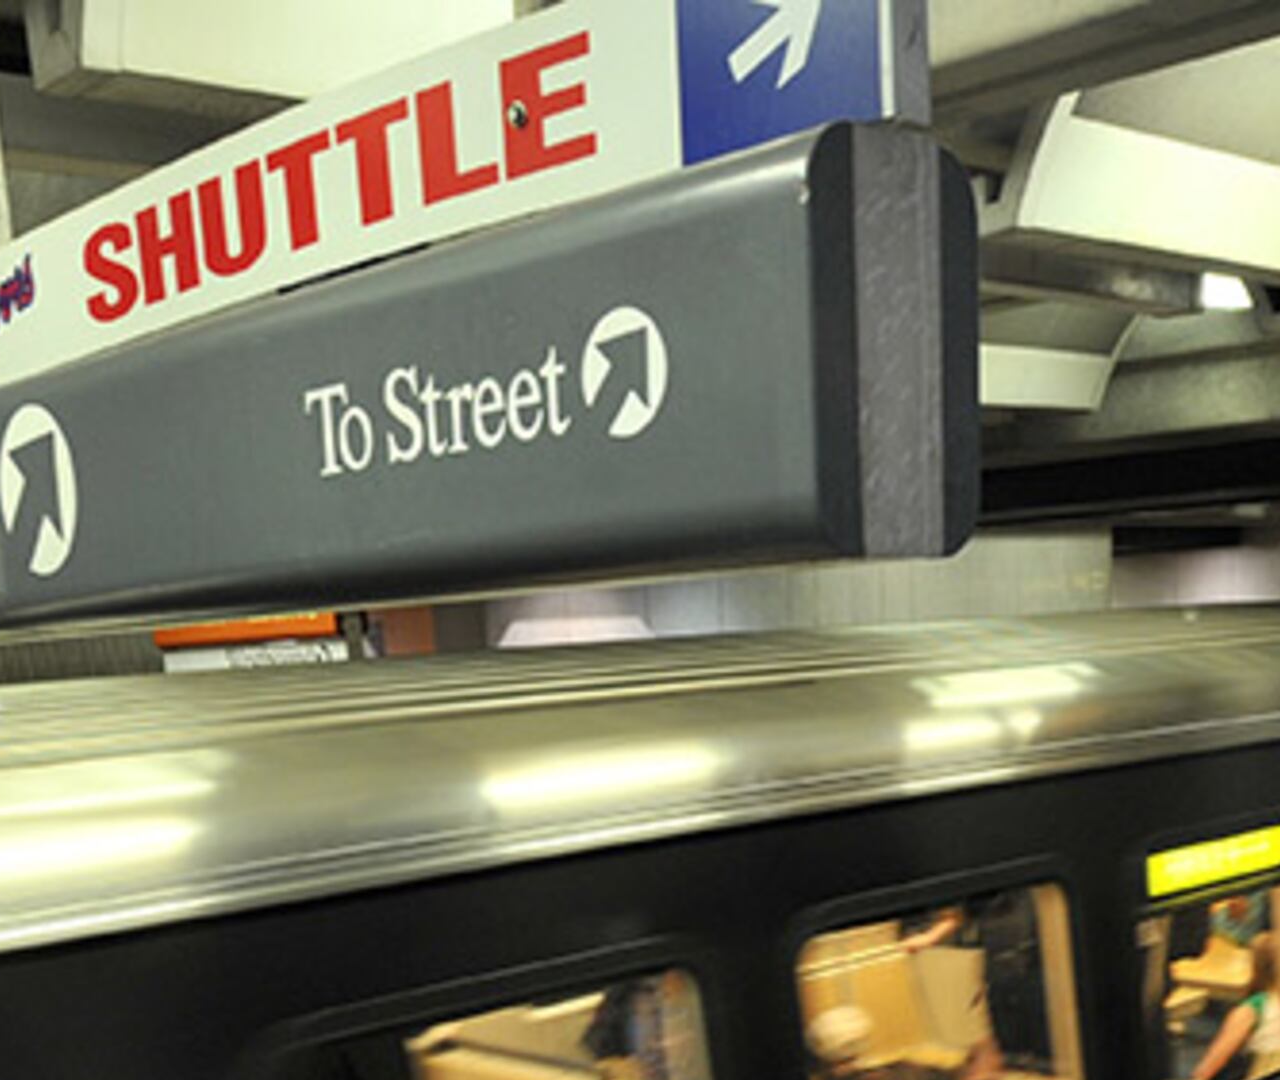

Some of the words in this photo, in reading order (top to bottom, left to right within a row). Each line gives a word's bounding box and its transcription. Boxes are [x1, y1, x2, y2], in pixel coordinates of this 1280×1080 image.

[83, 30, 598, 324] SHUTTLE
[305, 383, 374, 477] To
[384, 345, 572, 465] Street
